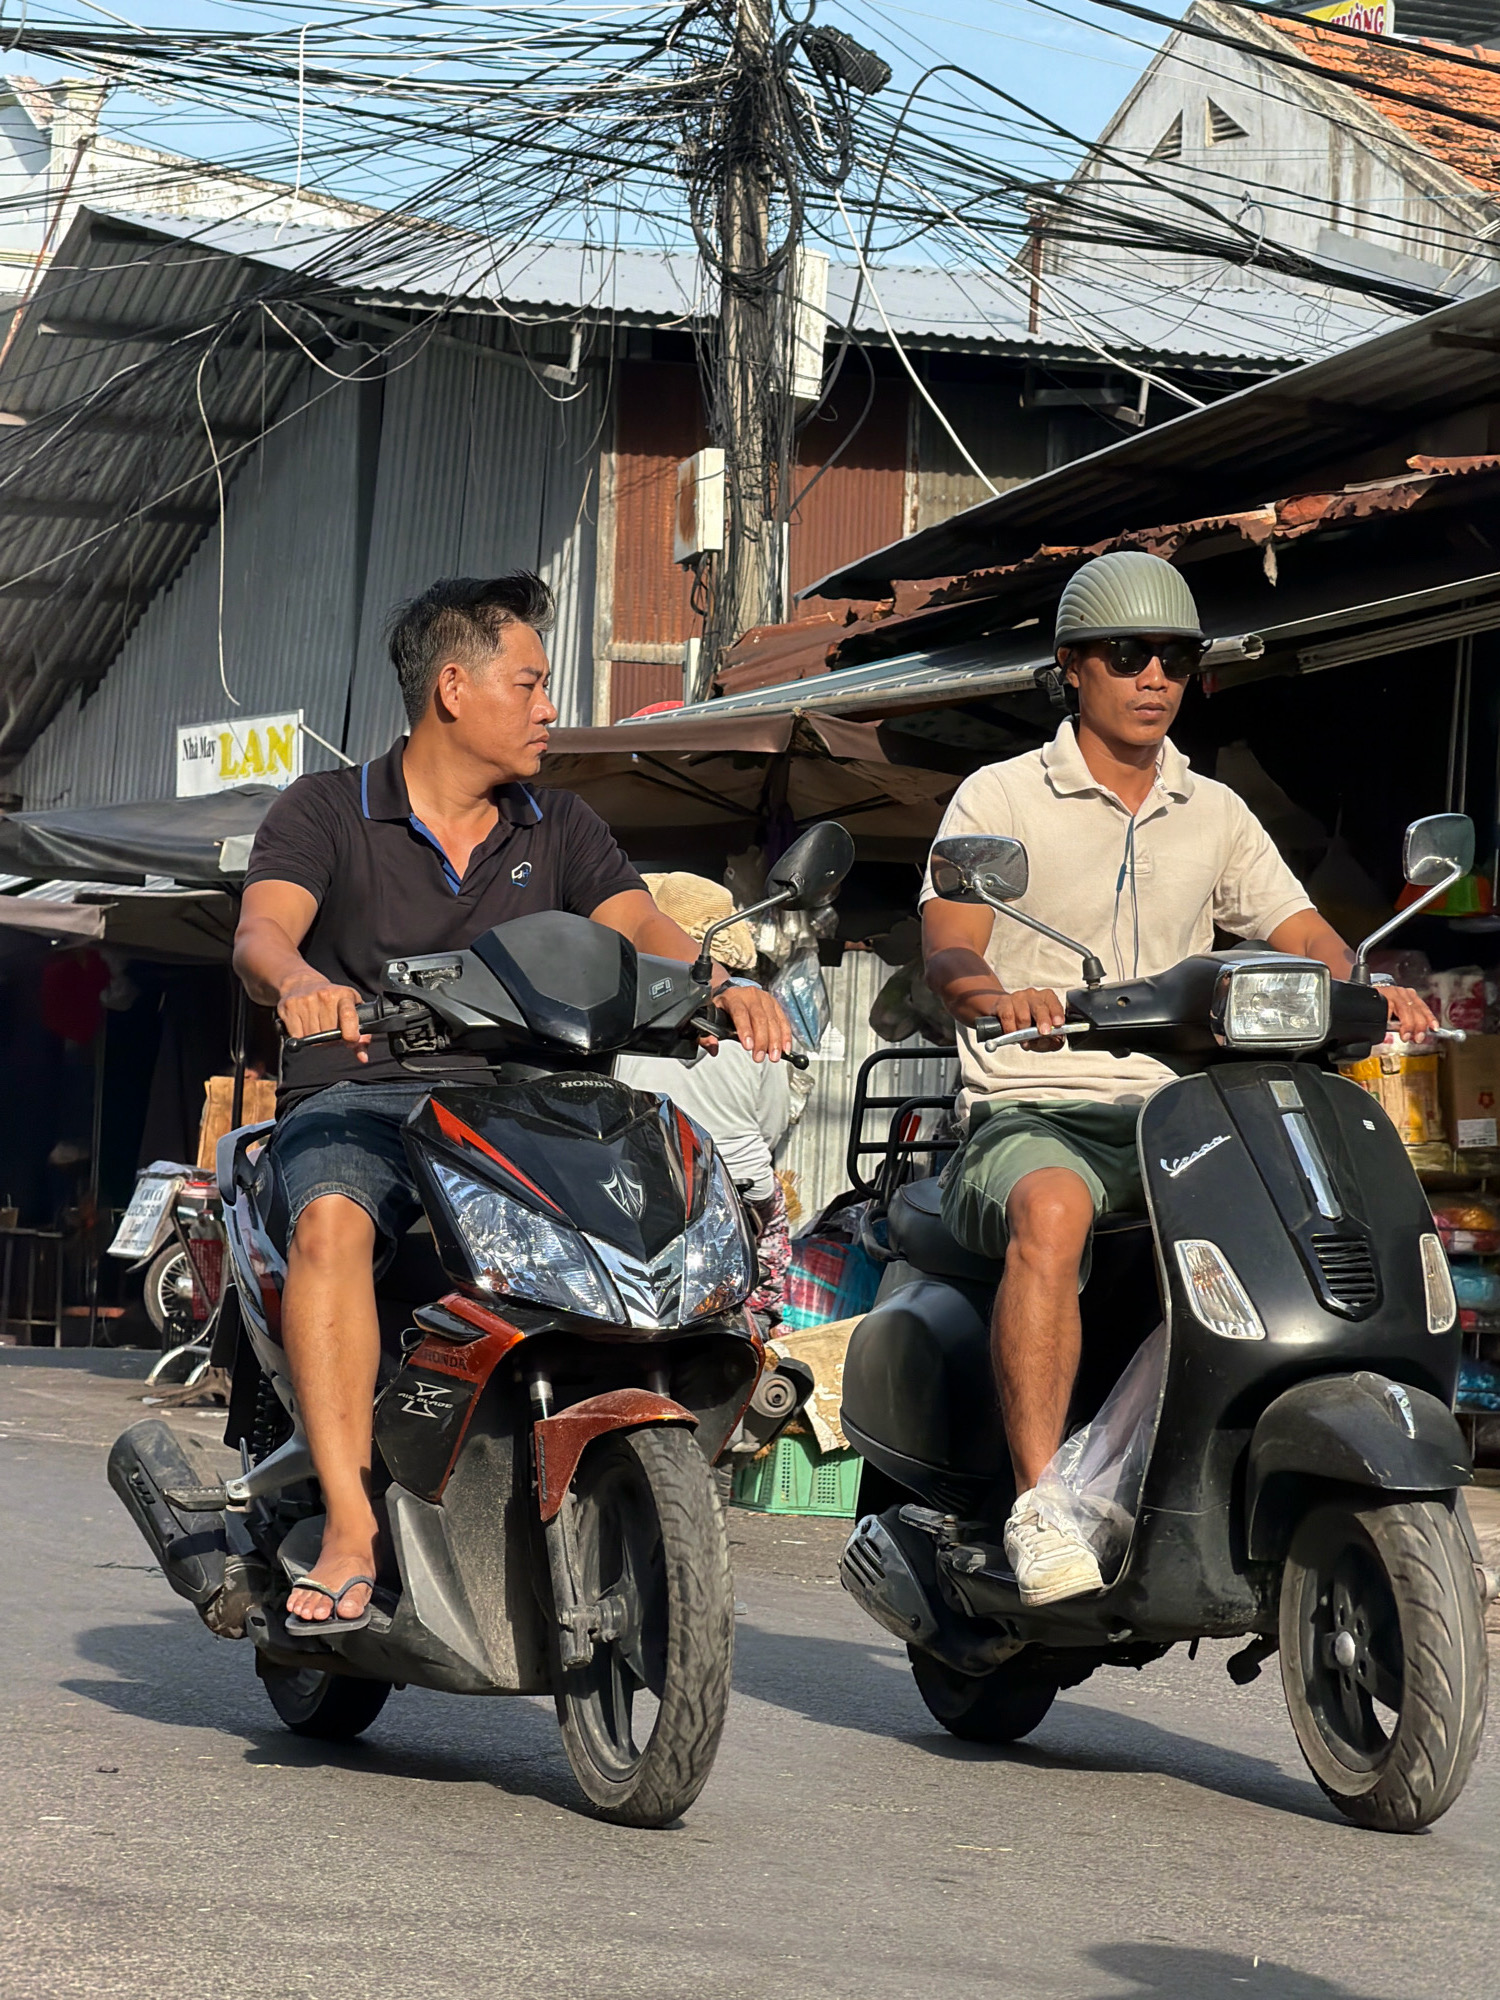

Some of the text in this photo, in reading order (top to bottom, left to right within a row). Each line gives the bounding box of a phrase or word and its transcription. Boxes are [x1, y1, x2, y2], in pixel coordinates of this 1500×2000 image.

[218, 723, 296, 780] LAN
[560, 1080, 615, 1089] HONDA
[1160, 1135, 1232, 1177] Vespa
[424, 1350, 468, 1371] HONDA
[397, 1392, 454, 1409] AIR BLADE
